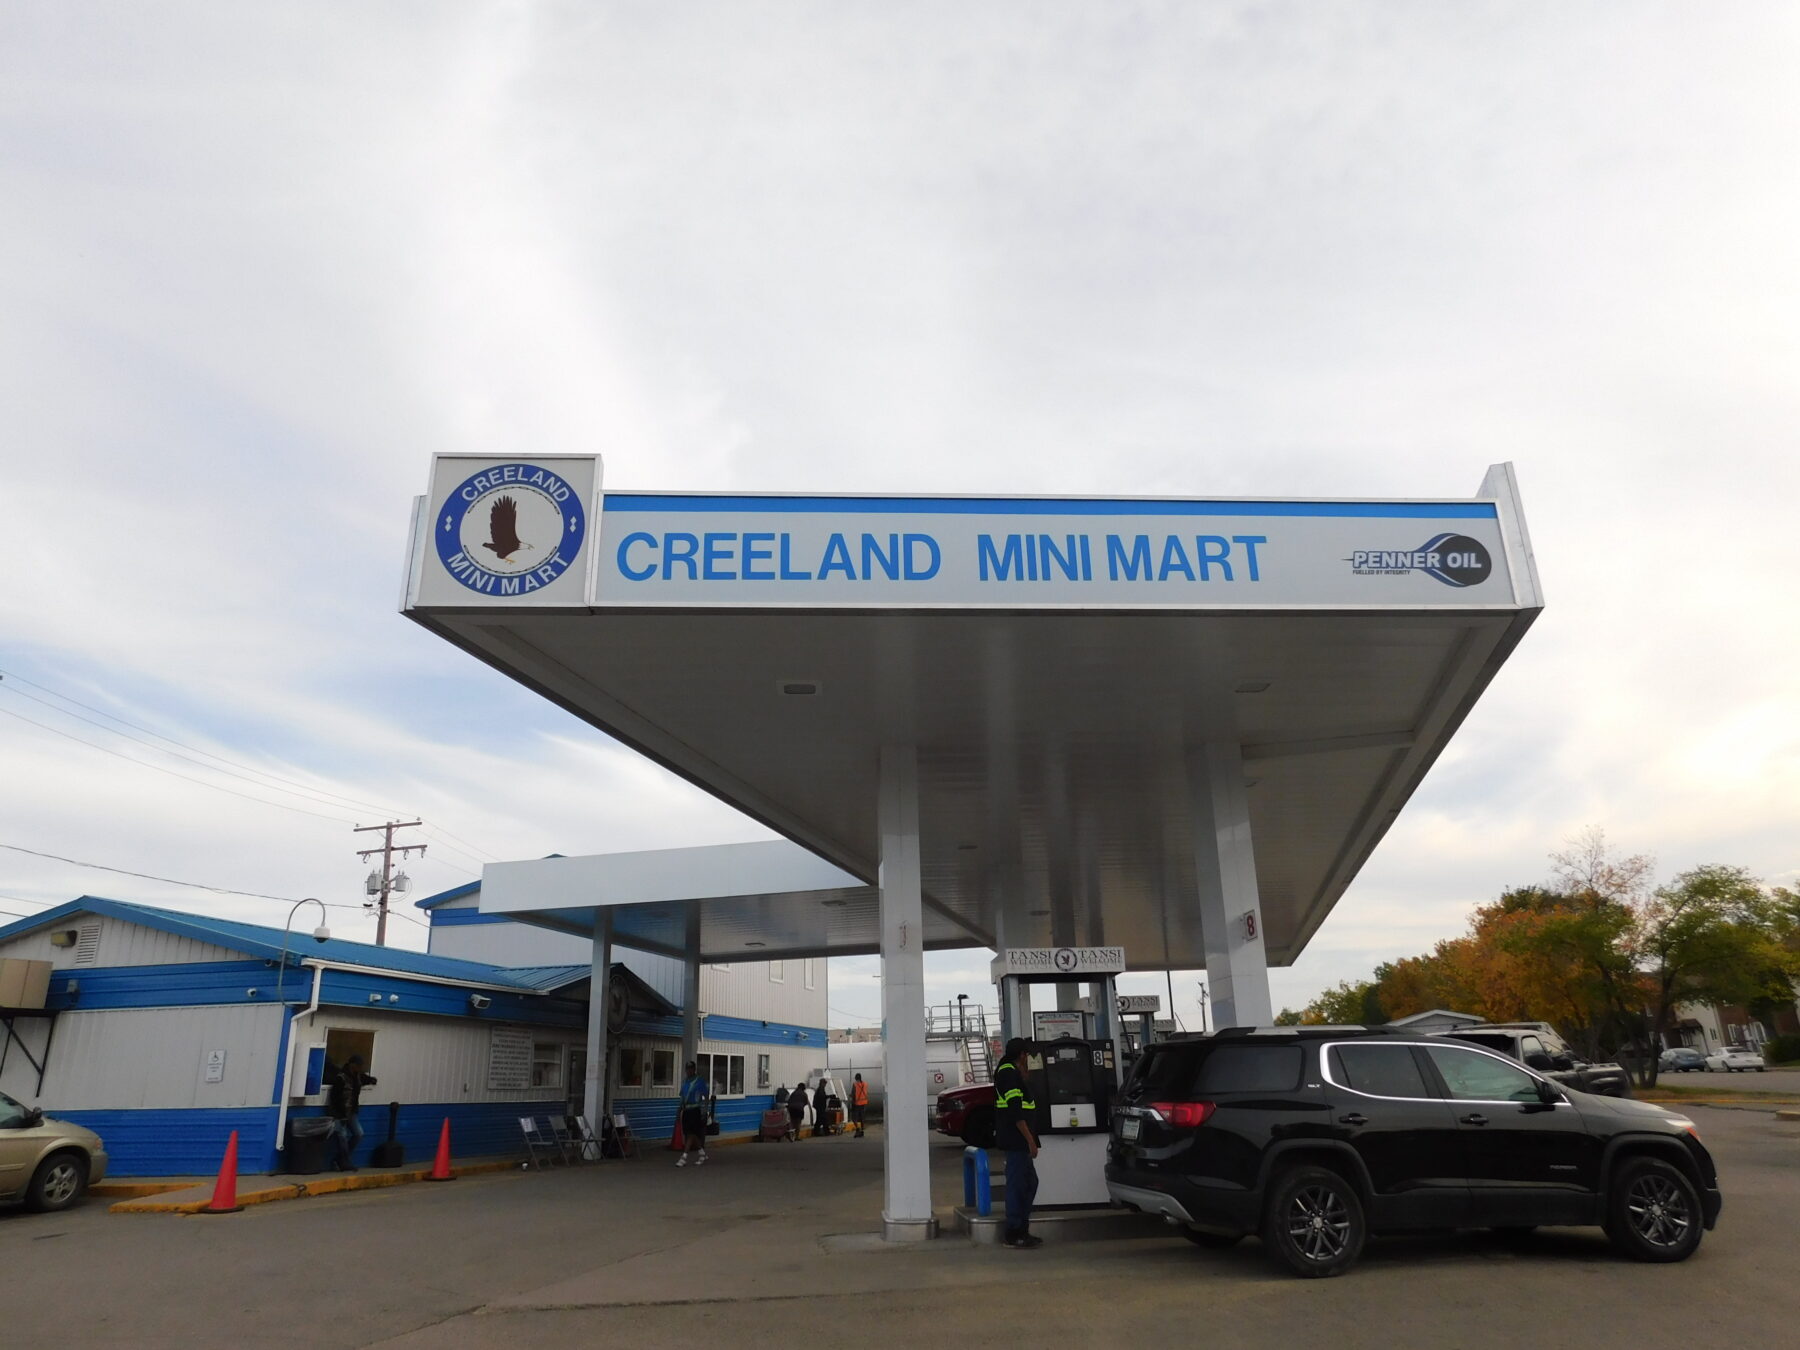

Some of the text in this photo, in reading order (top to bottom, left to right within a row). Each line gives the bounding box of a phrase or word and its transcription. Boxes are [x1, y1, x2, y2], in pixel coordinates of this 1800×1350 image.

[461, 466, 570, 502] CREELAND
[616, 531, 1268, 582] CREELAND MINI MART
[1353, 551, 1482, 568] PENNER OIL
[447, 551, 568, 594] MINI MART
[1247, 915, 1254, 936] 8
[1008, 951, 1052, 959] TANSI
[1078, 950, 1121, 958] TANSI
[1094, 1051, 1102, 1065] 8
